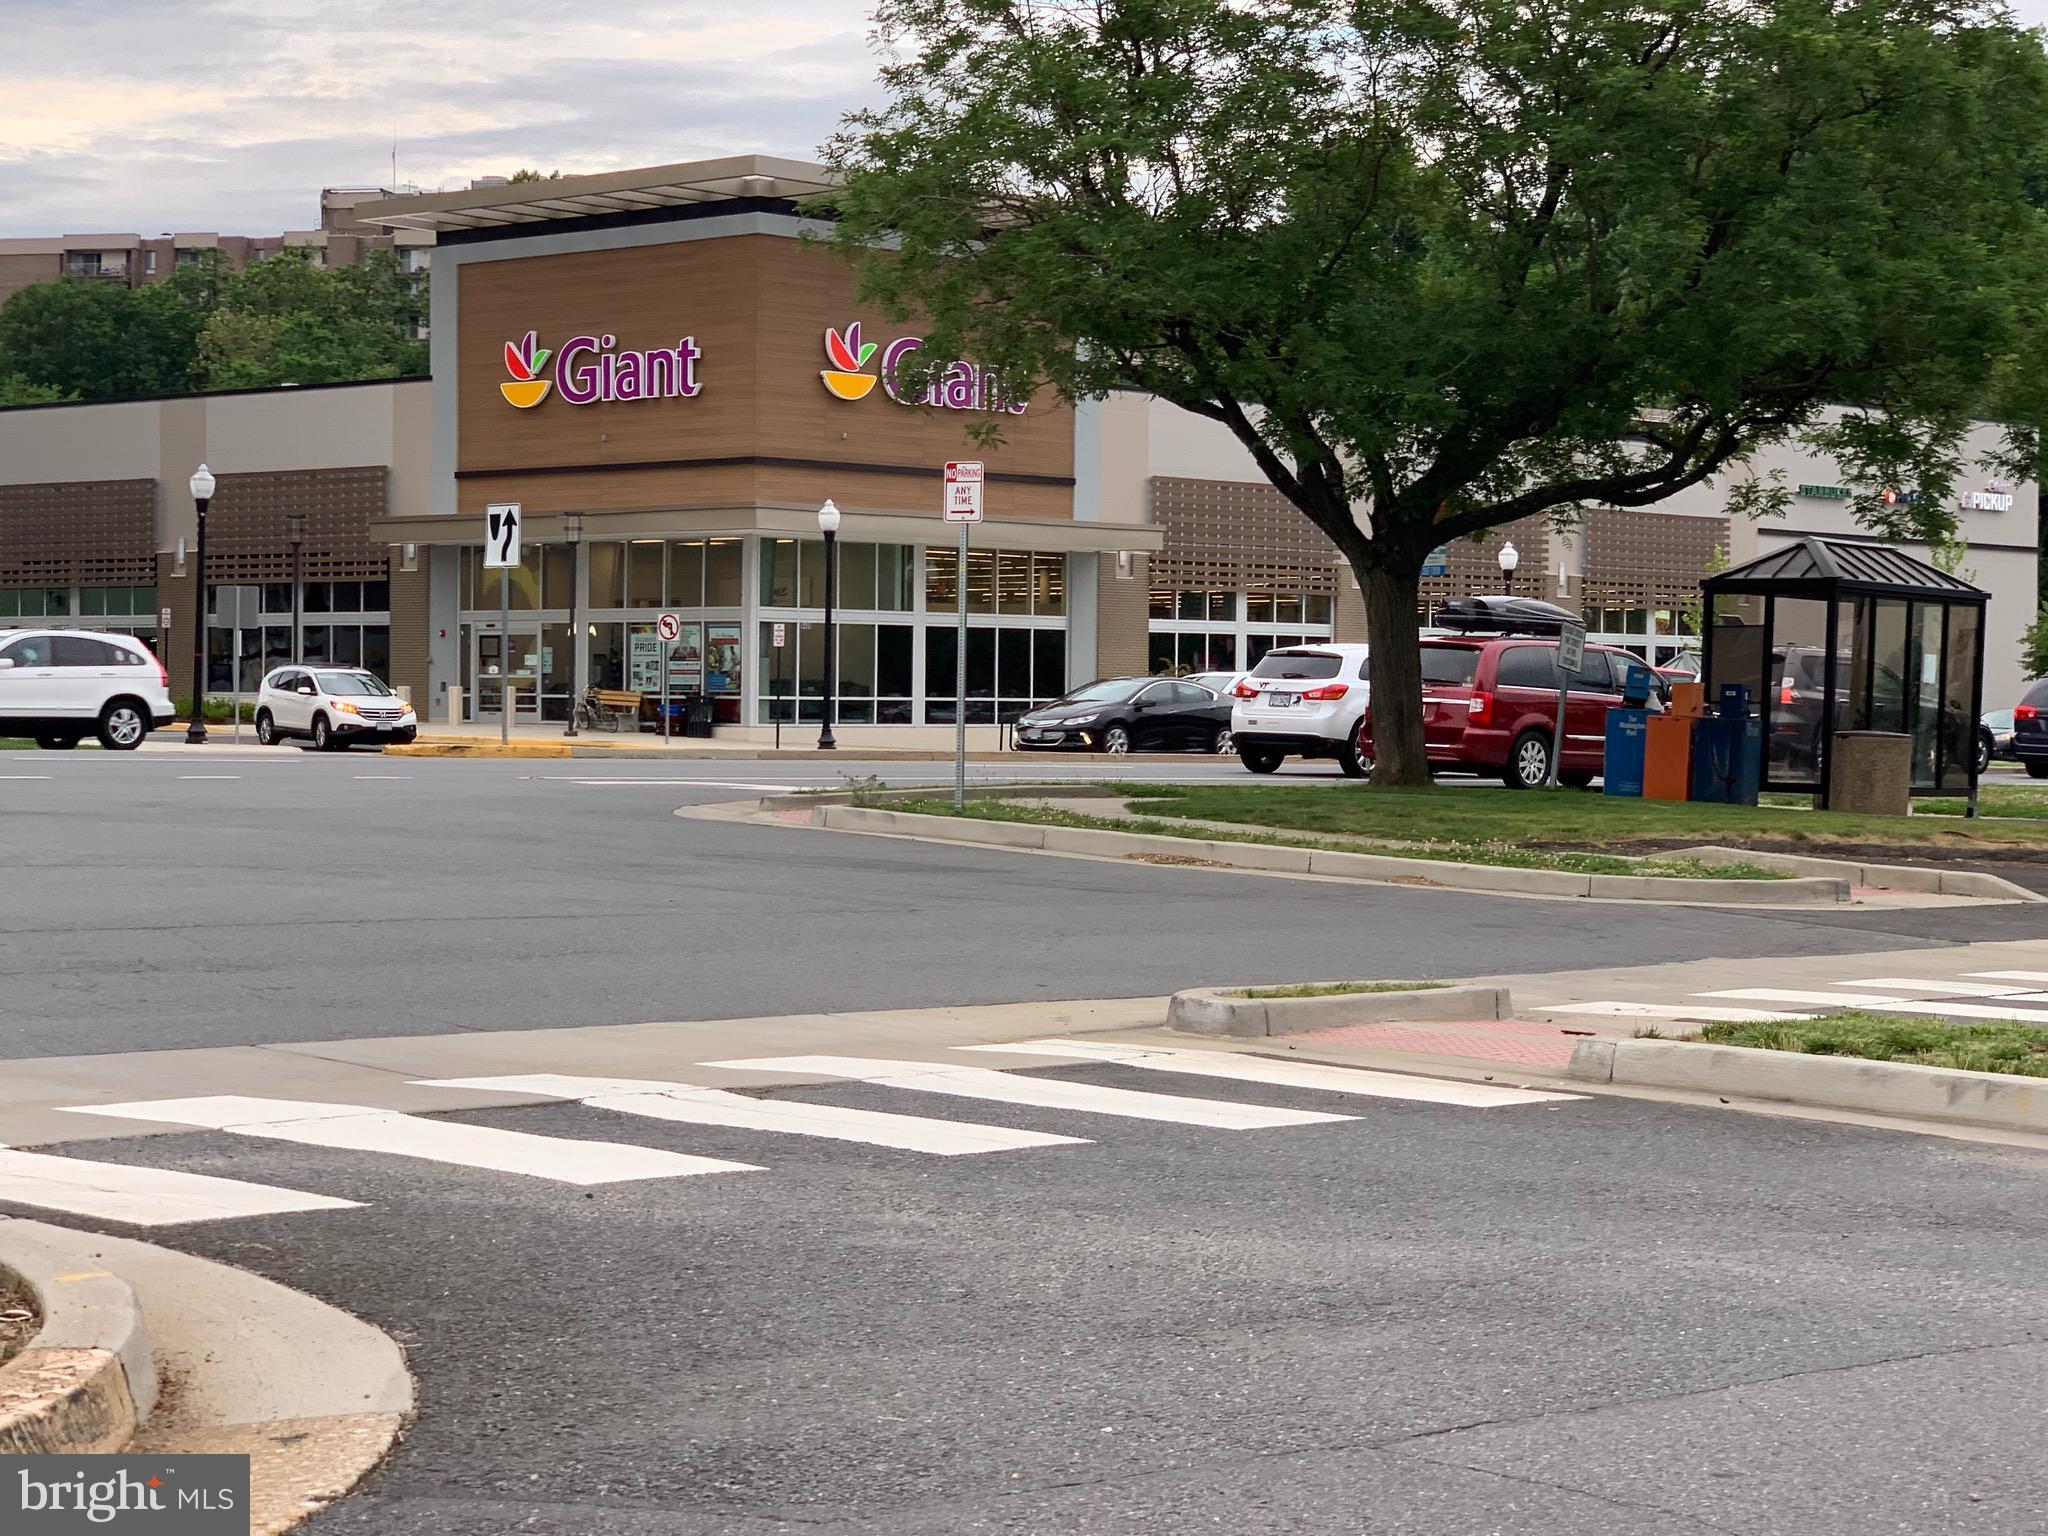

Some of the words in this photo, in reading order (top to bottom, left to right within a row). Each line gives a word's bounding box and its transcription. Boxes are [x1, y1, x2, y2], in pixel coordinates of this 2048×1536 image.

[556, 334, 702, 404] Giant
[947, 468, 957, 480] NO
[958, 468, 981, 478] PARKING
[955, 486, 971, 495] ANY
[954, 496, 973, 505] TIME
[1973, 492, 2013, 511] PICKUP
[634, 642, 657, 652] PRIDE
